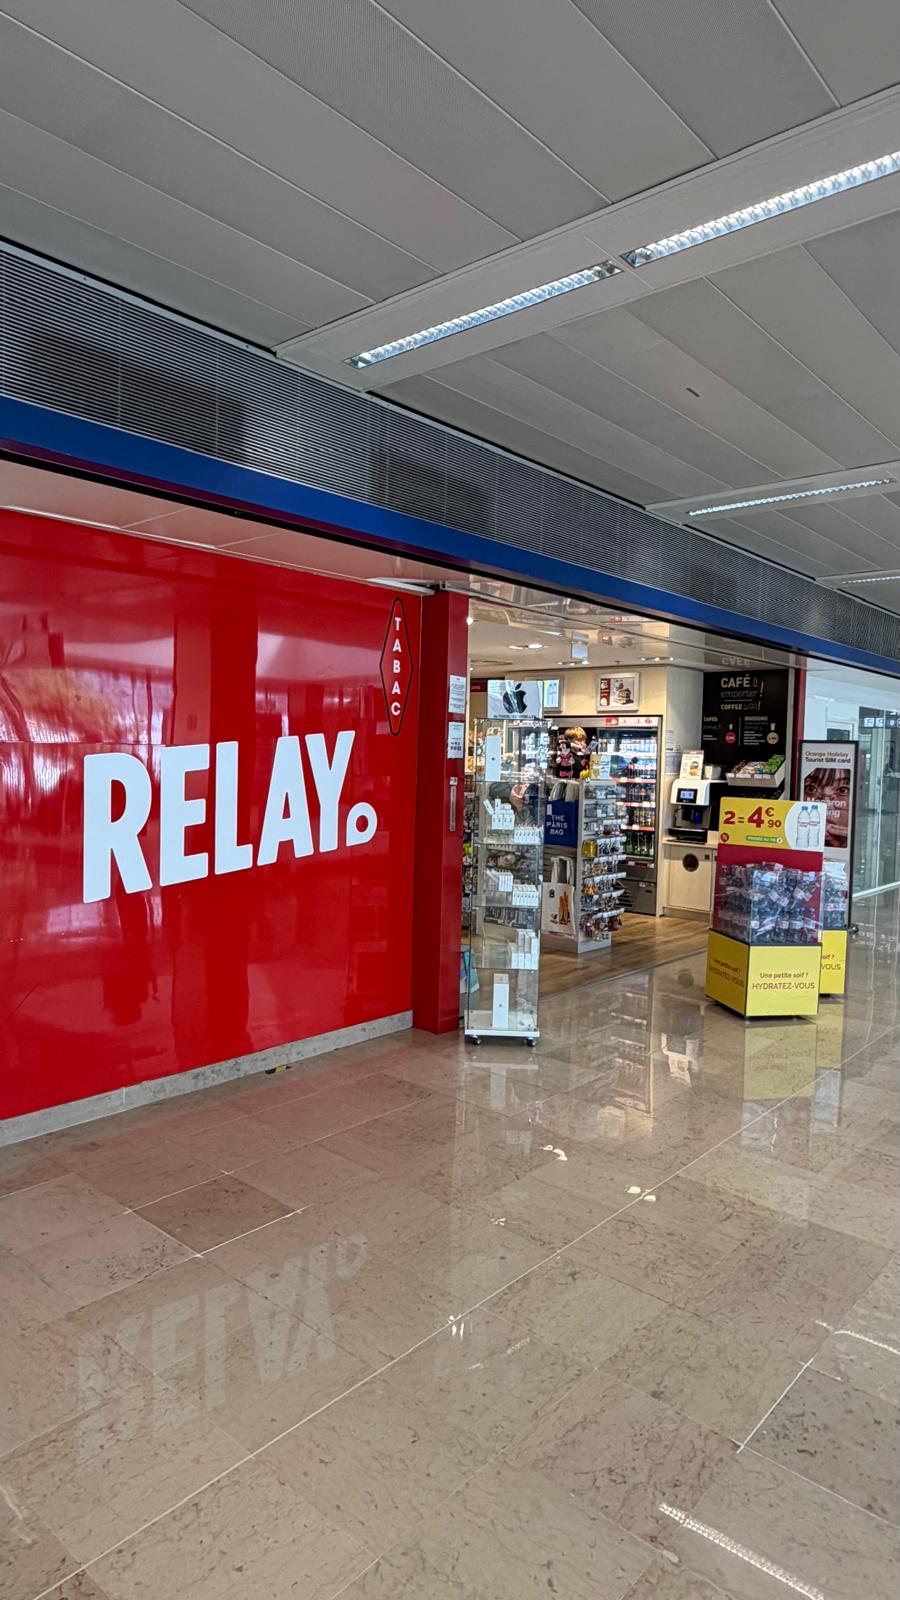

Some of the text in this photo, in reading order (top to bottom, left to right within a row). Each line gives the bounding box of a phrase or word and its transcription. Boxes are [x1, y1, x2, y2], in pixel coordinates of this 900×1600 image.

[390, 616, 402, 716] TABAC
[720, 674, 751, 688] CAFÉ
[546, 821, 568, 829] PARIS
[773, 972, 792, 980] petite
[793, 971, 805, 979] soif
[751, 982, 816, 990] HYDRATEZ-VOUS
